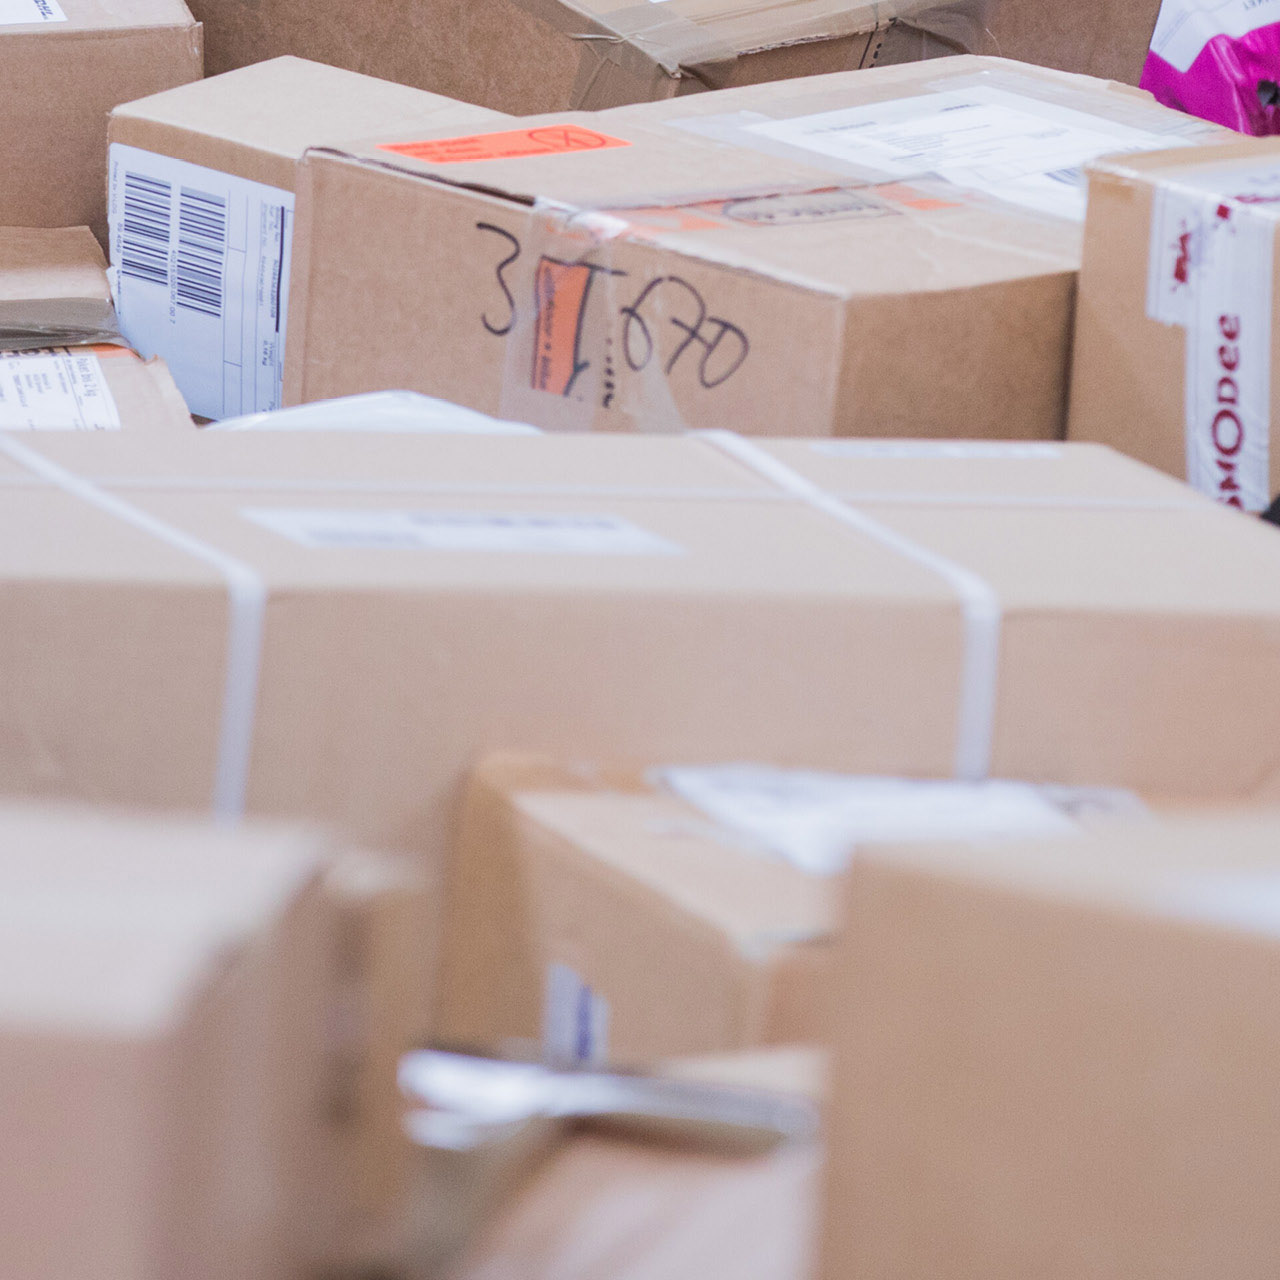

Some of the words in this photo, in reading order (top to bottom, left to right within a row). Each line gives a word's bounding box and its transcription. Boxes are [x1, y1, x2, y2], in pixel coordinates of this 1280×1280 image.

[75, 357, 88, 373] Paket
[78, 373, 91, 383] bis
[82, 389, 97, 398] kg
